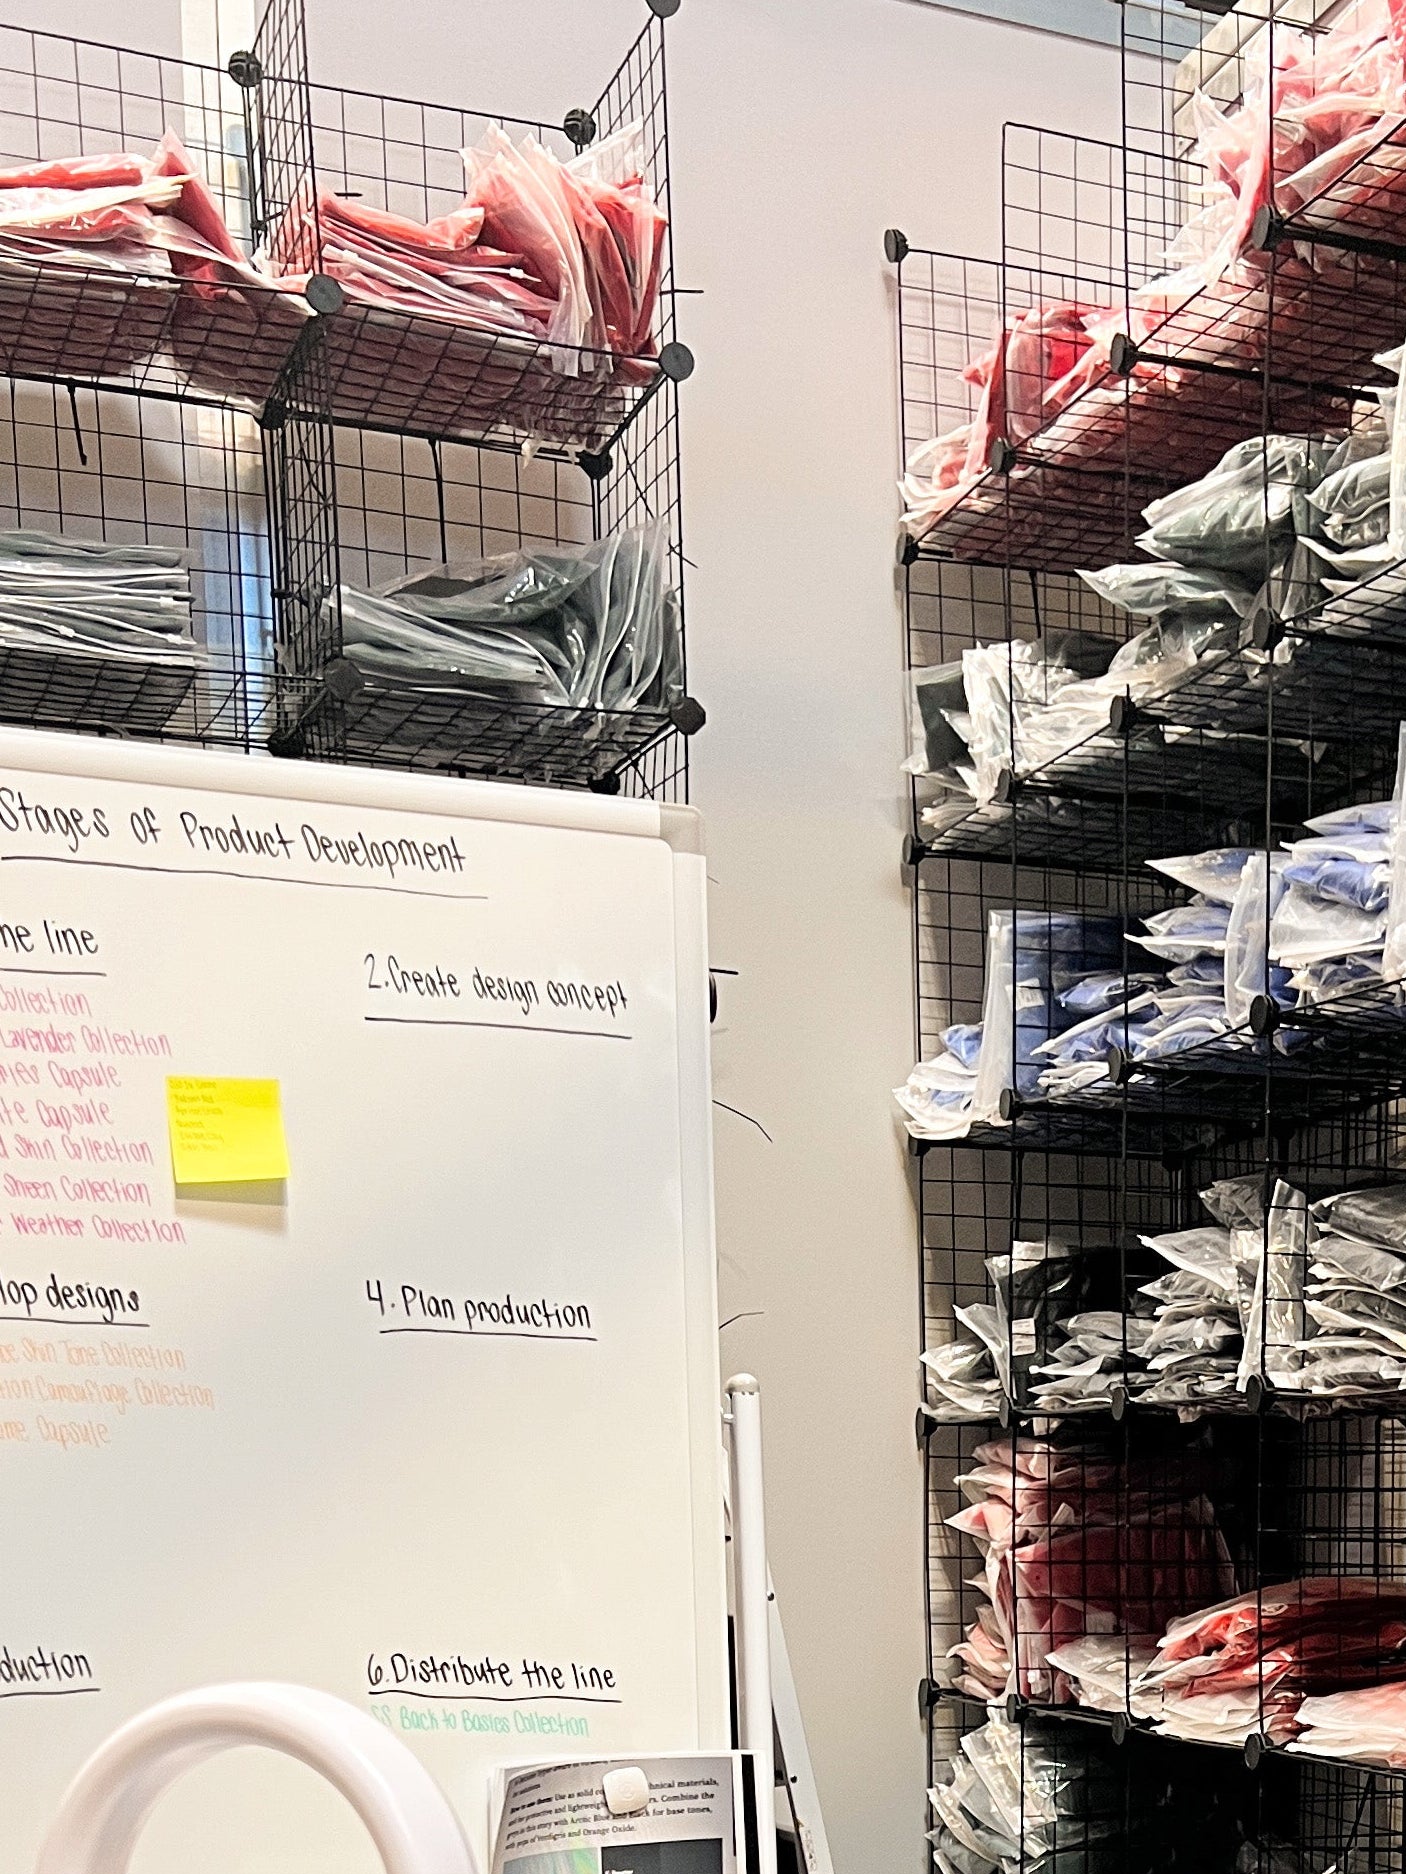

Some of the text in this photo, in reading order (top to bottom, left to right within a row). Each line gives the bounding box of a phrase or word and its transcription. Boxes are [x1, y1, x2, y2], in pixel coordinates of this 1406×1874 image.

[0, 786, 467, 879] Stages of Product Development
[43, 919, 99, 956] line
[472, 966, 540, 1016] design
[546, 980, 628, 1017] concept
[80, 1024, 173, 1057] Collection
[47, 1060, 122, 1096] Capsule
[36, 1099, 114, 1134] Capsule
[61, 1134, 154, 1166] Collection
[60, 1175, 152, 1207] Collection
[10, 1212, 187, 1244] Weather Collection
[46, 1273, 140, 1324] designs
[366, 1279, 591, 1330] 4. Plan production
[102, 1341, 187, 1370] Collection
[134, 1377, 215, 1411] Collection
[36, 1414, 112, 1451] Capsule
[521, 1659, 565, 1689] the
[571, 1662, 616, 1690] line
[441, 1708, 457, 1730] to
[513, 1710, 590, 1737] Collection
